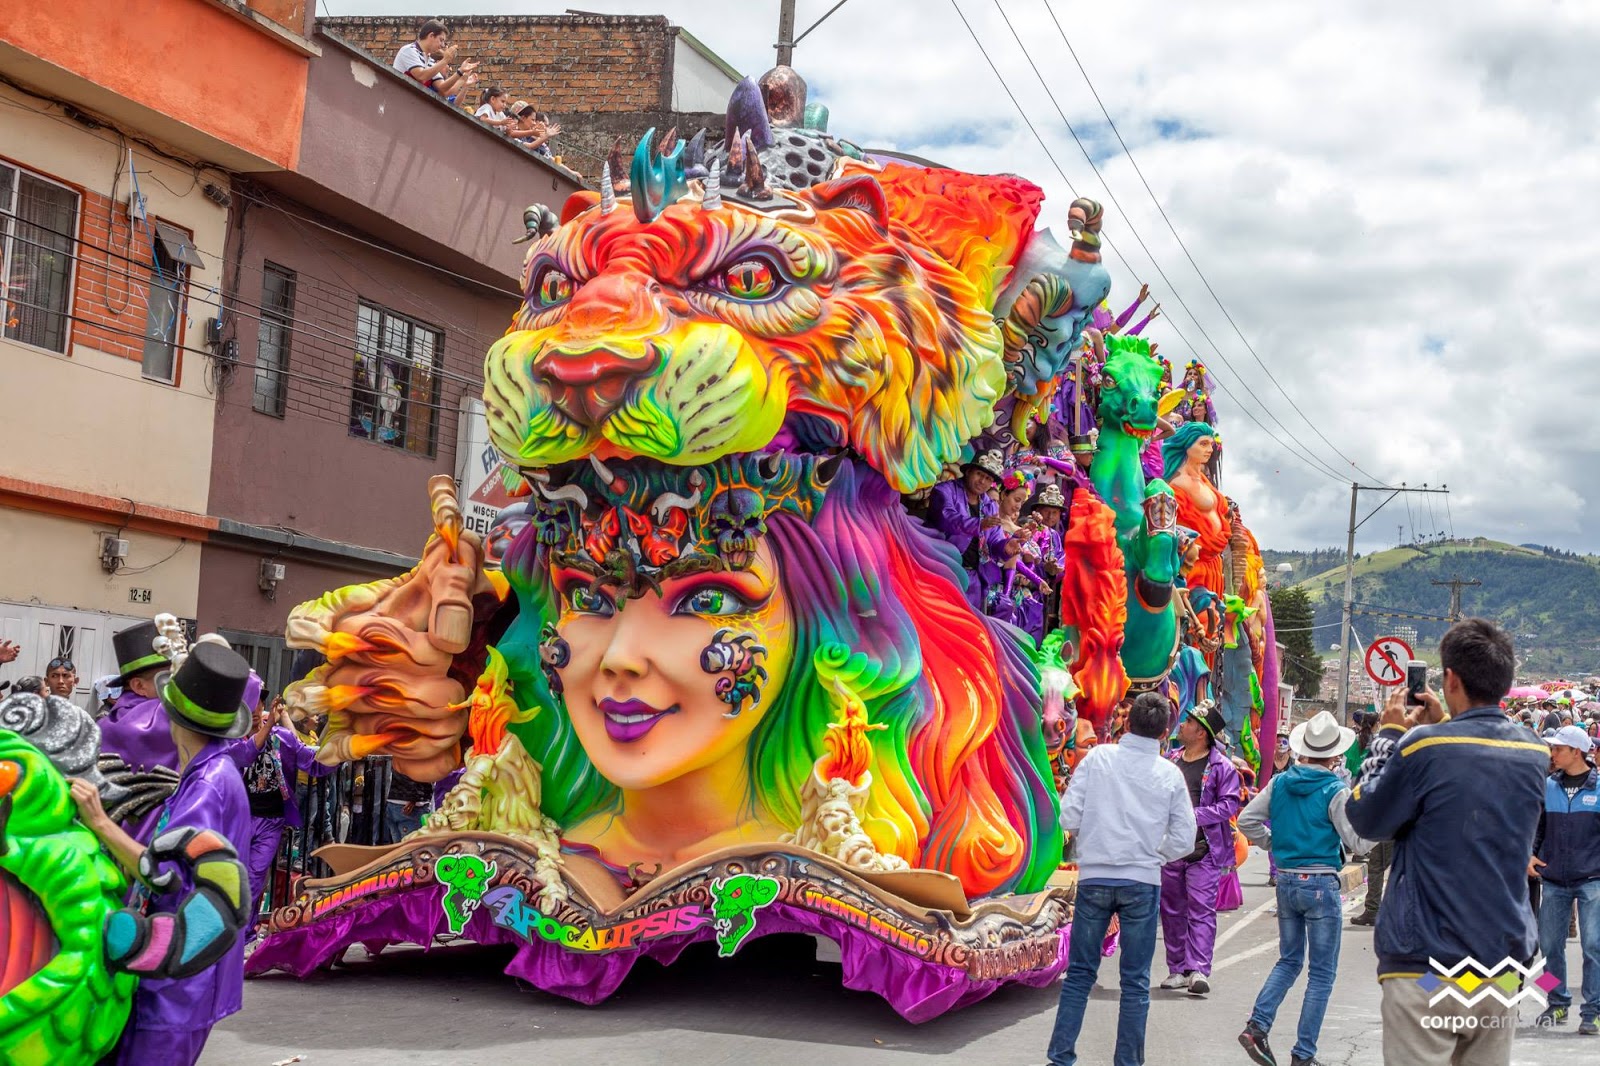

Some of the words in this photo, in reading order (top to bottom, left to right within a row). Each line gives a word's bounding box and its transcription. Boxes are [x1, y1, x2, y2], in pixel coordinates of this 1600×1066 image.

[482, 885, 716, 952] APOCALIPSIS
[805, 890, 869, 928] VICENTE
[869, 914, 930, 956] REVELO
